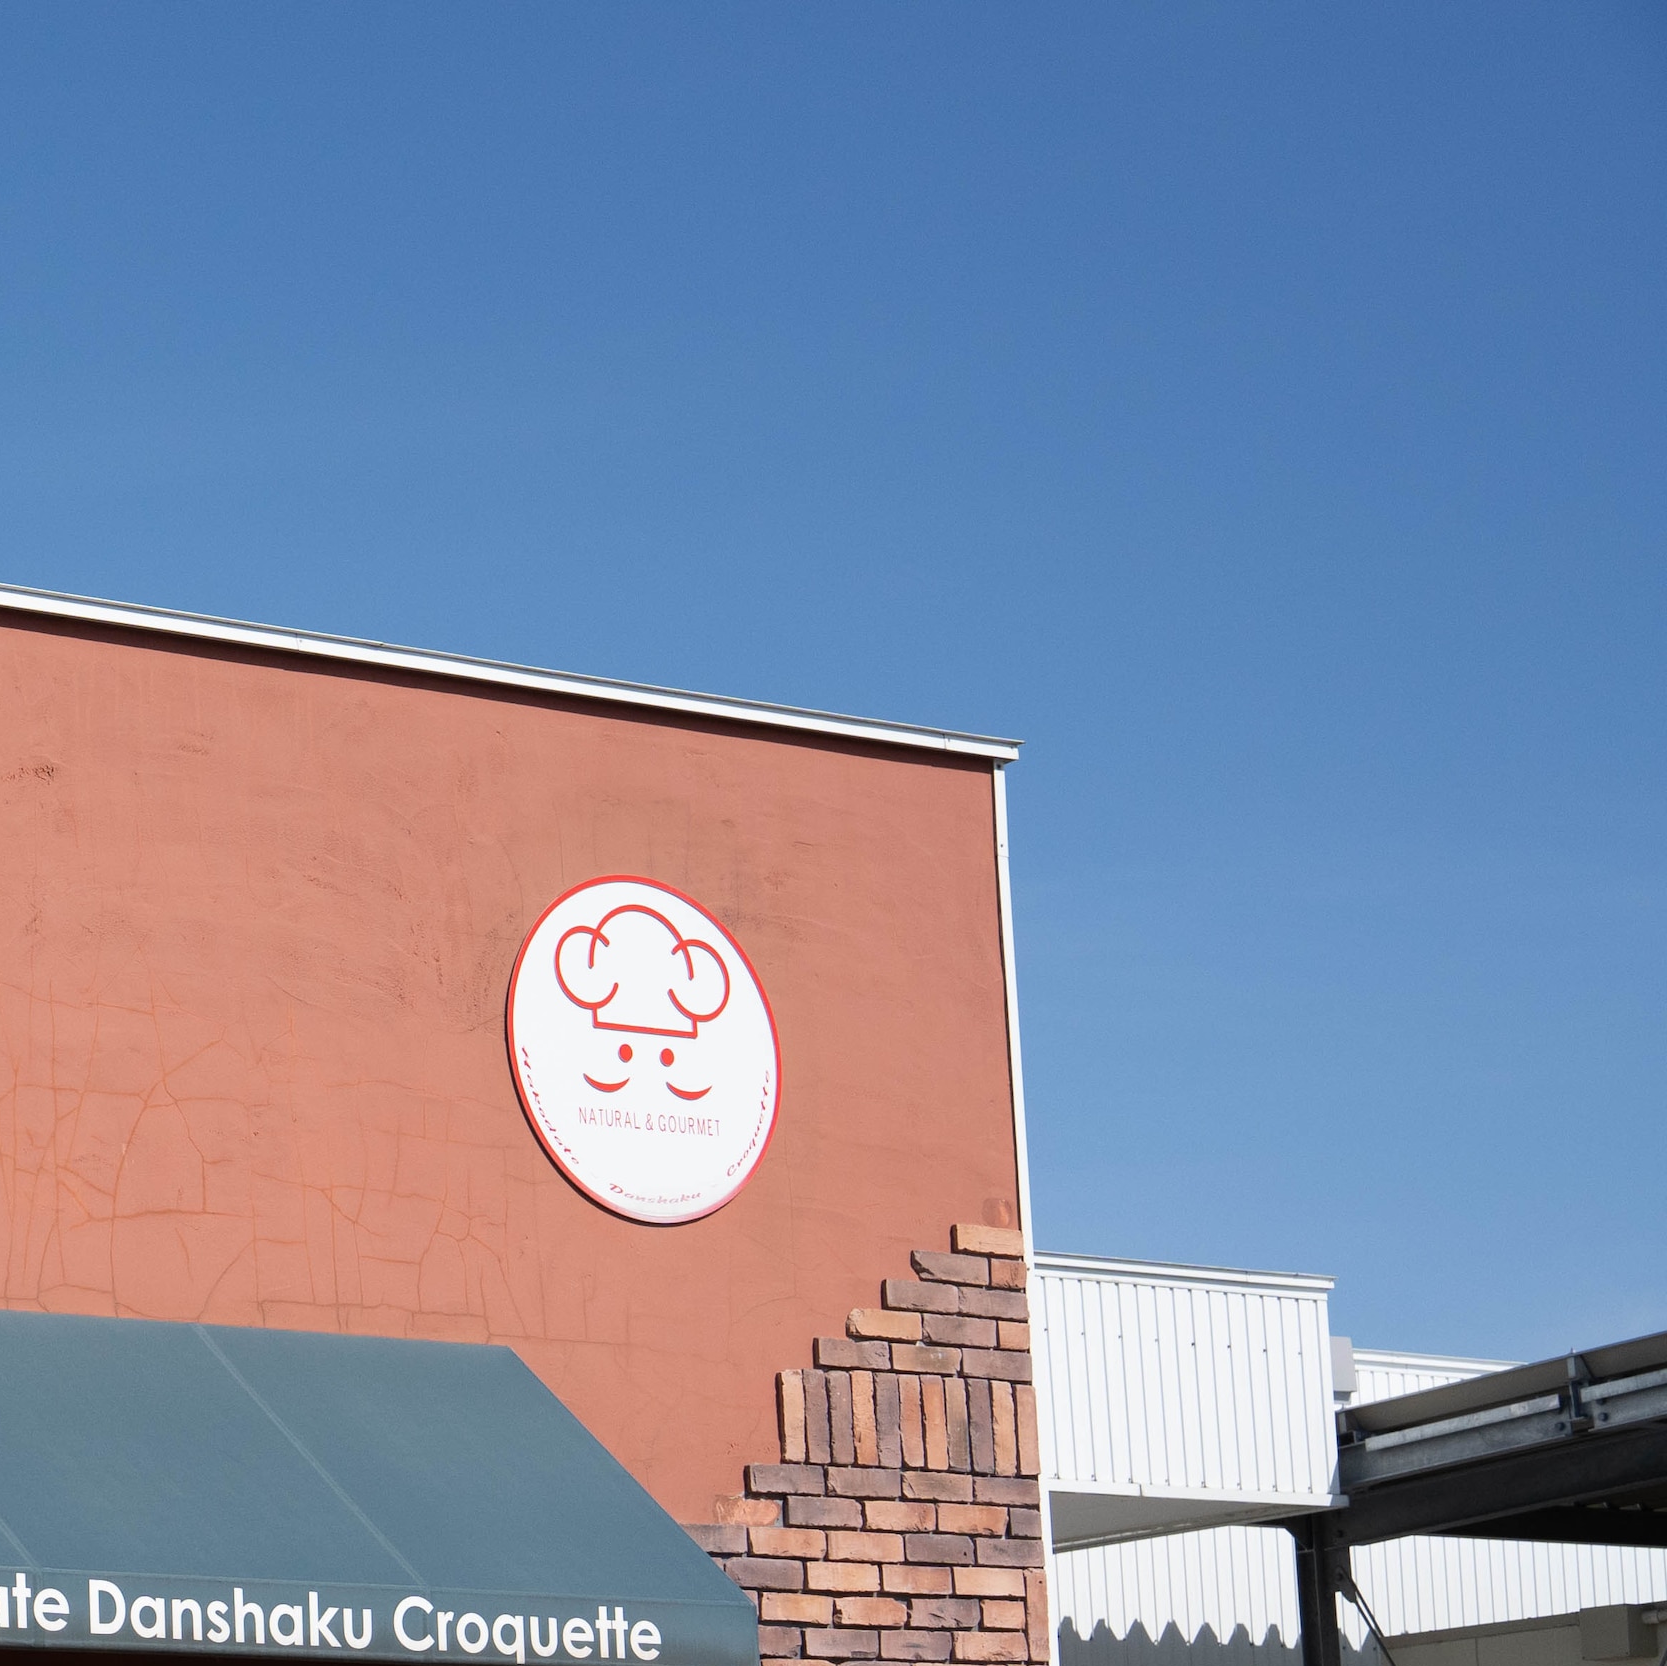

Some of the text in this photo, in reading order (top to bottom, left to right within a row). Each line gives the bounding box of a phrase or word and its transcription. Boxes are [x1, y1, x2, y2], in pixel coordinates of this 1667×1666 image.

[577, 1106, 722, 1137] NATURAL & GOURMET
[88, 1579, 373, 1651] Danshaku
[393, 1595, 664, 1666] Croquette
